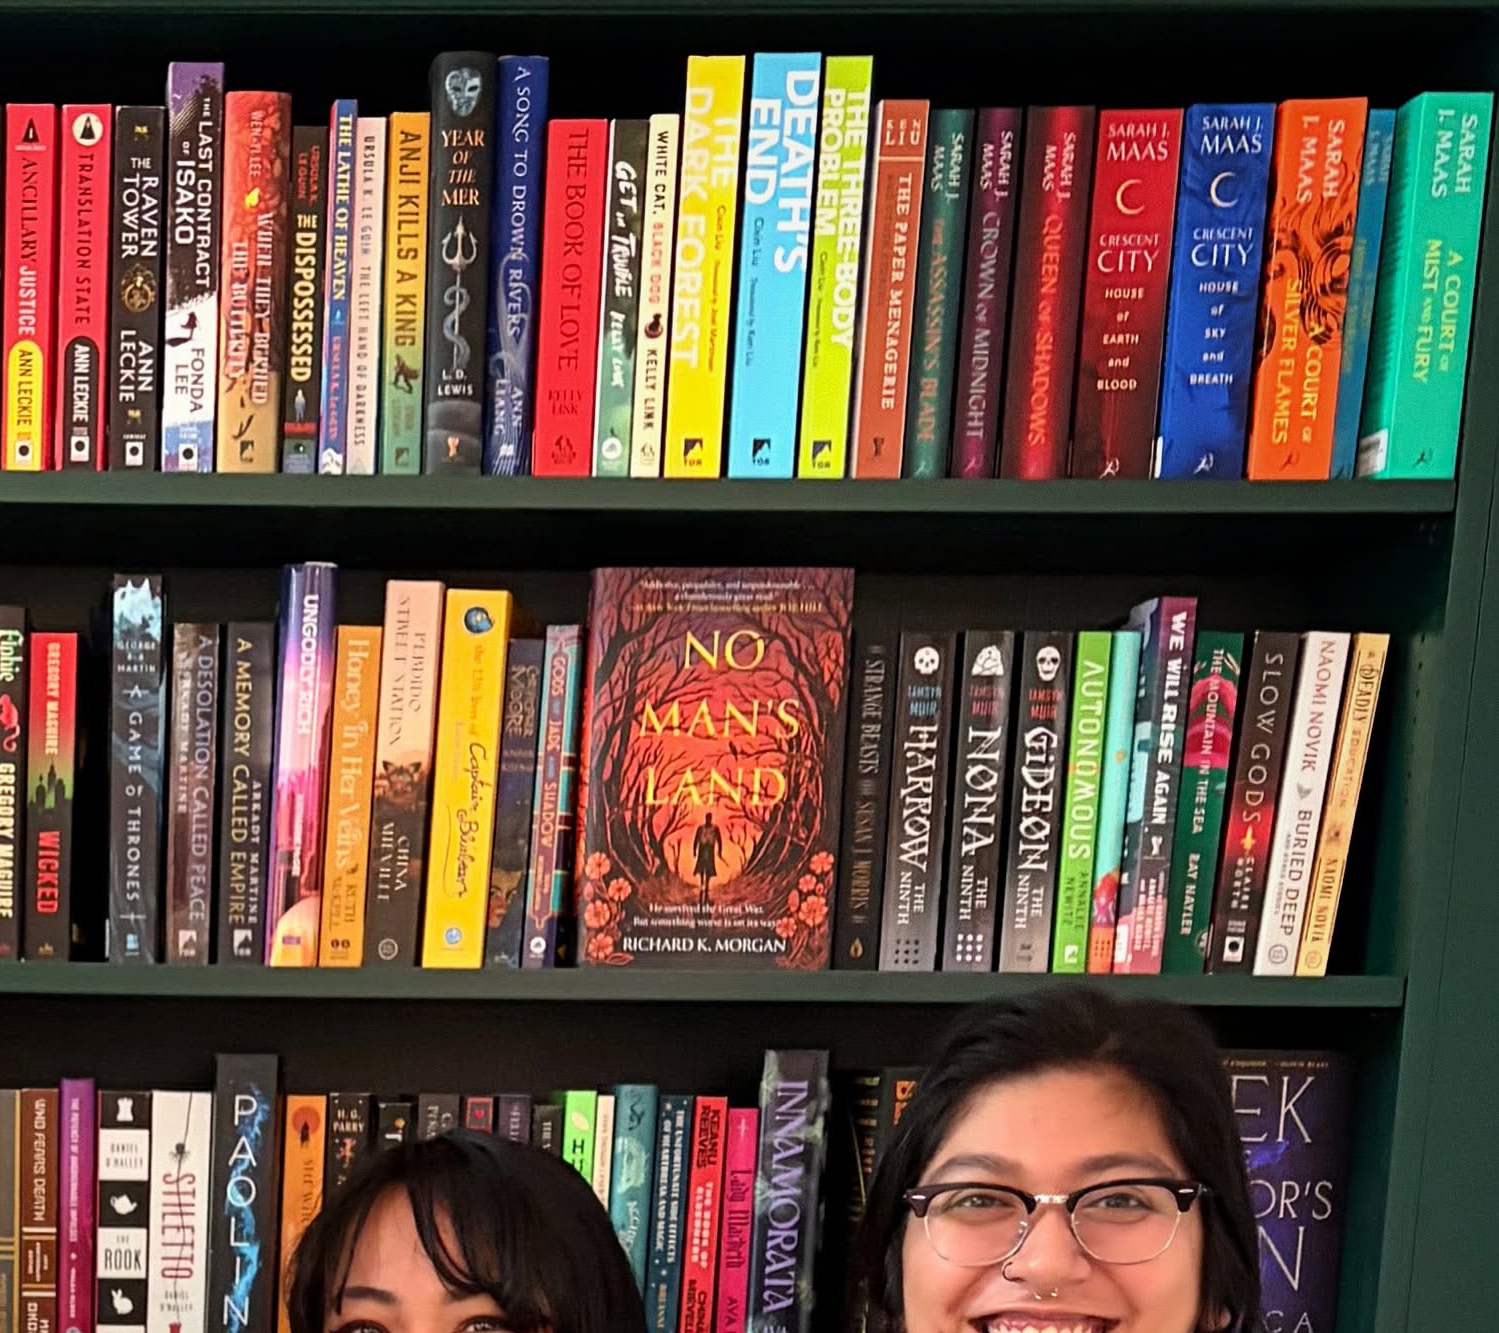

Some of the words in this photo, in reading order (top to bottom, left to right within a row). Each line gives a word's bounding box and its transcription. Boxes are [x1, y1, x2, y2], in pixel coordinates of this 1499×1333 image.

[182, 142, 189, 155] OF
[198, 122, 213, 174] LAST
[441, 130, 485, 149] YEAR
[681, 88, 712, 200] DARK
[843, 88, 870, 147] THE
[1108, 124, 1156, 138] SARAH
[131, 158, 152, 169] THE
[400, 130, 421, 183] ANJI
[711, 117, 740, 189] THE
[745, 98, 781, 205] END
[774, 70, 820, 273] DEATH'S
[814, 89, 846, 237] PROBLEM
[1106, 142, 1169, 162] MAAS
[22, 158, 38, 264] ANCILLARY
[121, 174, 140, 259] TOWER
[141, 176, 159, 257] RAVEN
[176, 160, 196, 245] ISAKO
[297, 214, 317, 228] THE
[397, 192, 420, 261] KILLS
[441, 188, 479, 207] MER
[196, 178, 213, 288] CONTRACT
[831, 151, 867, 347] THREE-BODY
[1097, 250, 1159, 274] CITY
[1100, 235, 1159, 246] CRESCENT
[19, 265, 36, 337] JUSTICE
[291, 232, 317, 382] DISPOSSESSED
[396, 270, 416, 284] A
[669, 215, 707, 367] FOREST
[394, 292, 416, 348] KING
[1103, 334, 1139, 345] EARTH
[1285, 278, 1301, 352] SILVER
[438, 383, 473, 396] LEWIS
[1097, 380, 1137, 390] BLOOD
[1190, 374, 1233, 385] BREATH
[1272, 357, 1299, 445] FLAMES
[237, 638, 252, 652] A
[684, 631, 765, 670] NO
[1169, 611, 1187, 651] WE
[1163, 656, 1180, 704] WILL
[1256, 653, 1284, 734] SLOW
[1310, 639, 1335, 703] NAOMI
[234, 657, 252, 757] MEMORY
[640, 699, 800, 737] MAN'S
[1158, 708, 1177, 763] RISE
[129, 712, 143, 773] GAME
[1069, 660, 1105, 859] AUTONOMOUS
[1301, 708, 1324, 772] NOVIK
[125, 785, 143, 796] OF
[231, 763, 250, 843] CALLED
[646, 767, 786, 806] LAND
[901, 726, 938, 872] HARROW
[1017, 726, 1058, 872] GIDEON
[1154, 769, 1171, 825] AGAIN
[1242, 742, 1270, 823] GODS
[37, 832, 60, 913] WICKED
[127, 809, 141, 901] THRONES
[229, 851, 245, 925] EMPIRE
[623, 936, 694, 953] RICHARD
[698, 938, 712, 953] K.
[715, 938, 786, 953] MORGAN
[695, 1105, 710, 1169] REEVES
[706, 1111, 720, 1165] KEANU
[161, 1172, 195, 1280] STILETTO
[762, 1081, 809, 1313] INNAMORATA
[104, 1250, 141, 1271] ROOK
